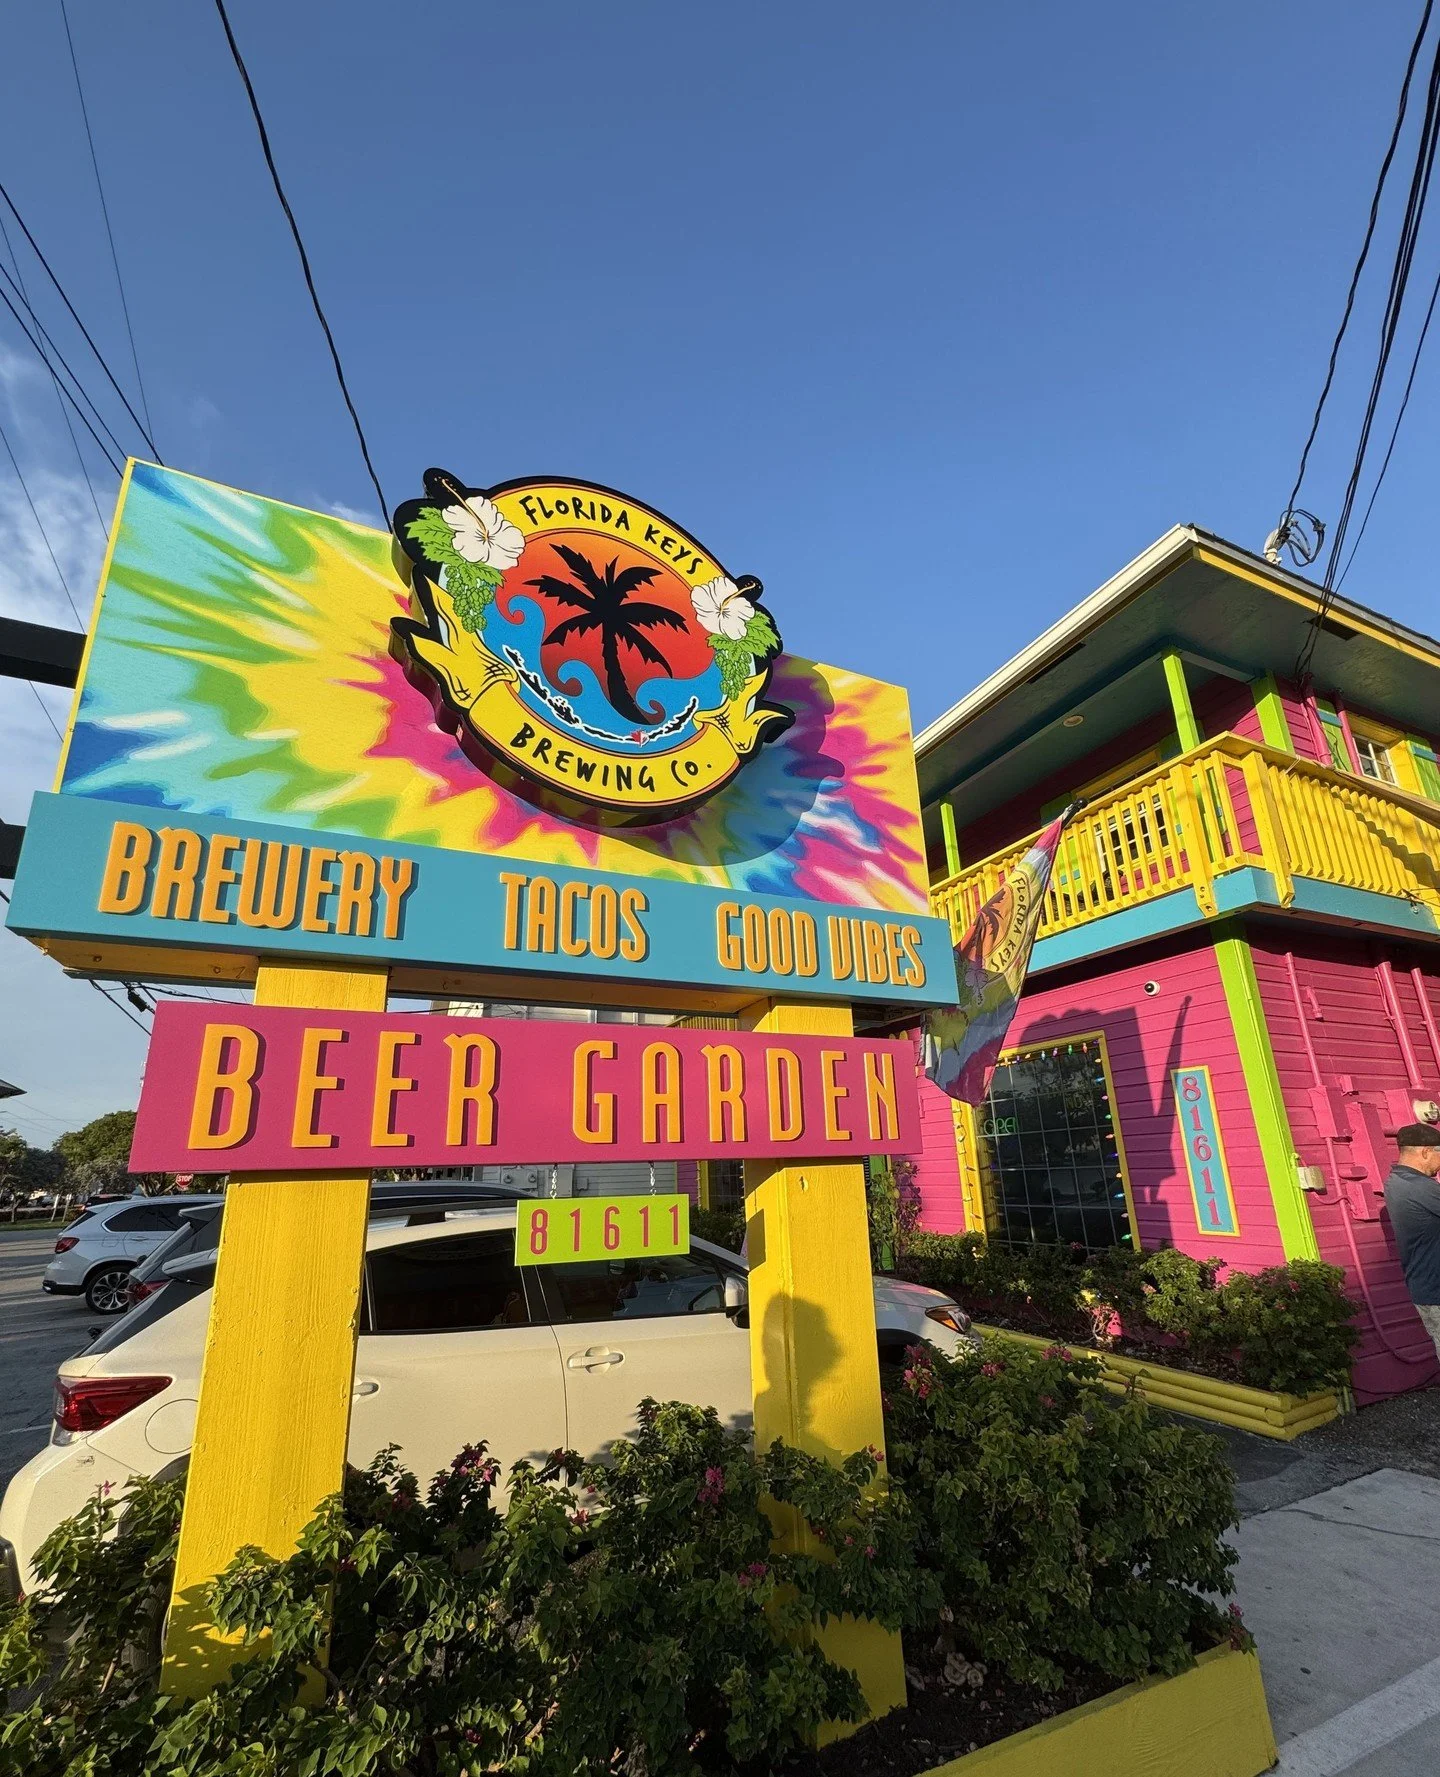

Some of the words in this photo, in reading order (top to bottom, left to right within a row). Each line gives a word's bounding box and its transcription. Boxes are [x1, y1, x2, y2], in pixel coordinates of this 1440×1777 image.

[518, 495, 630, 532] FLORIDA
[644, 524, 704, 576] KEYS
[509, 722, 656, 793] BREWING
[670, 758, 712, 787] CO.
[97, 821, 414, 939] BREWERY
[499, 872, 648, 962] TACOS
[715, 901, 818, 977] GOOD
[826, 915, 926, 988] VIBES
[1011, 877, 1028, 935] FLORIDA
[990, 939, 1017, 972] KEYS
[187, 1023, 498, 1149] BEER
[571, 1039, 900, 1144] GARDEN
[1181, 1075, 1222, 1226] 81611
[529, 1203, 680, 1255] 81611
